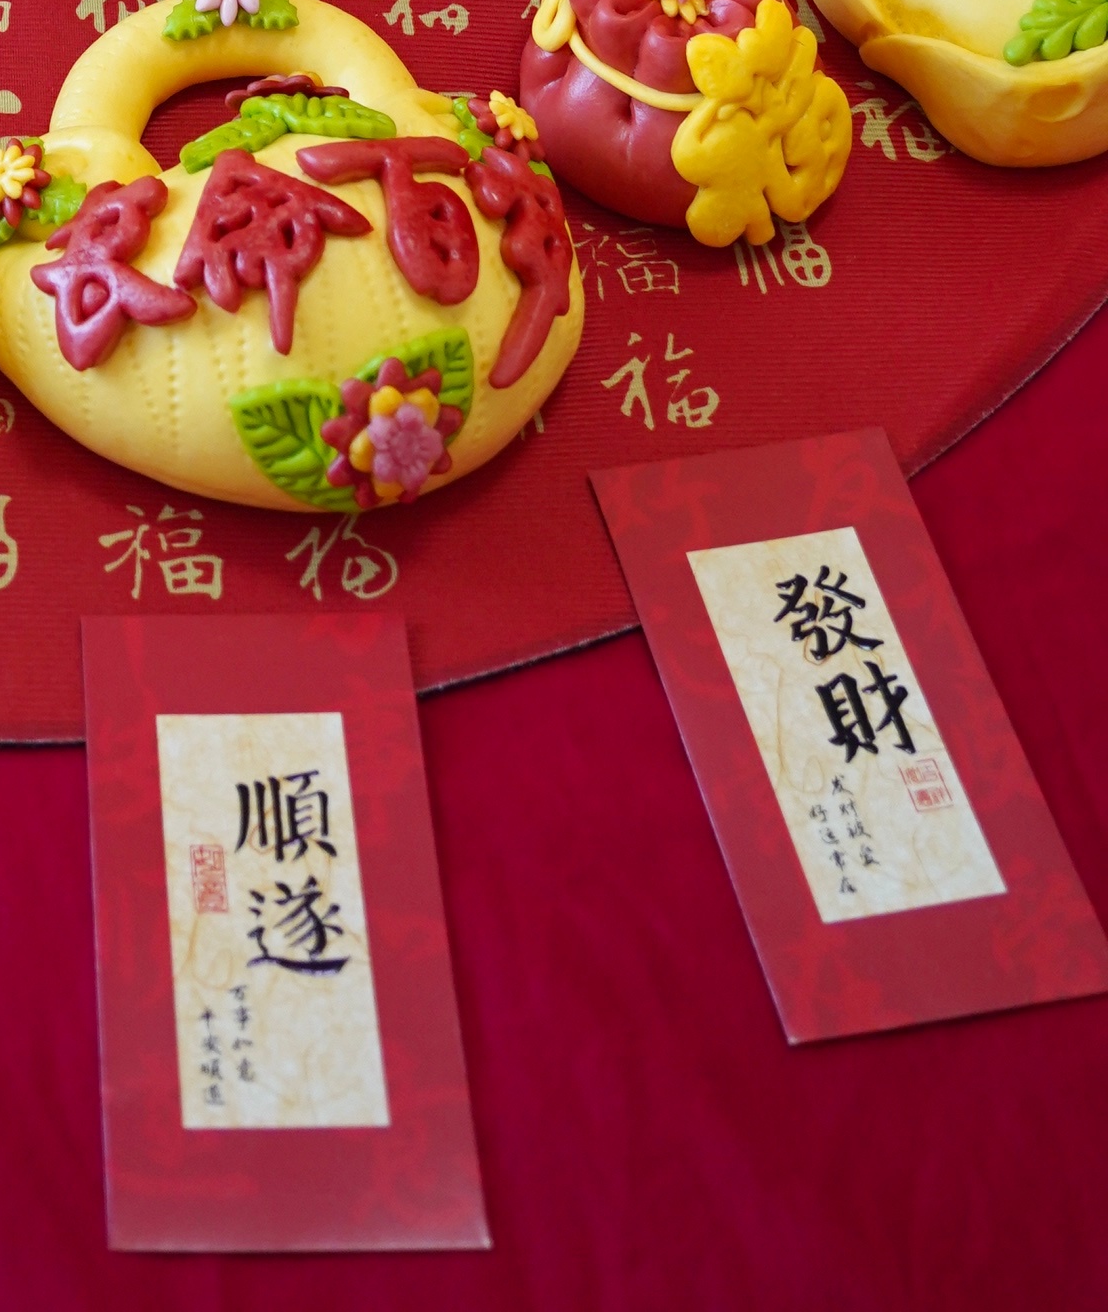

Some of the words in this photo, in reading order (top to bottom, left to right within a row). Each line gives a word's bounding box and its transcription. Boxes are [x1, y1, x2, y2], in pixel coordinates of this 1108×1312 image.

[600, 331, 721, 430] 福
[99, 505, 224, 601] 福
[772, 563, 918, 764] 發財
[233, 768, 351, 978] 順遂
